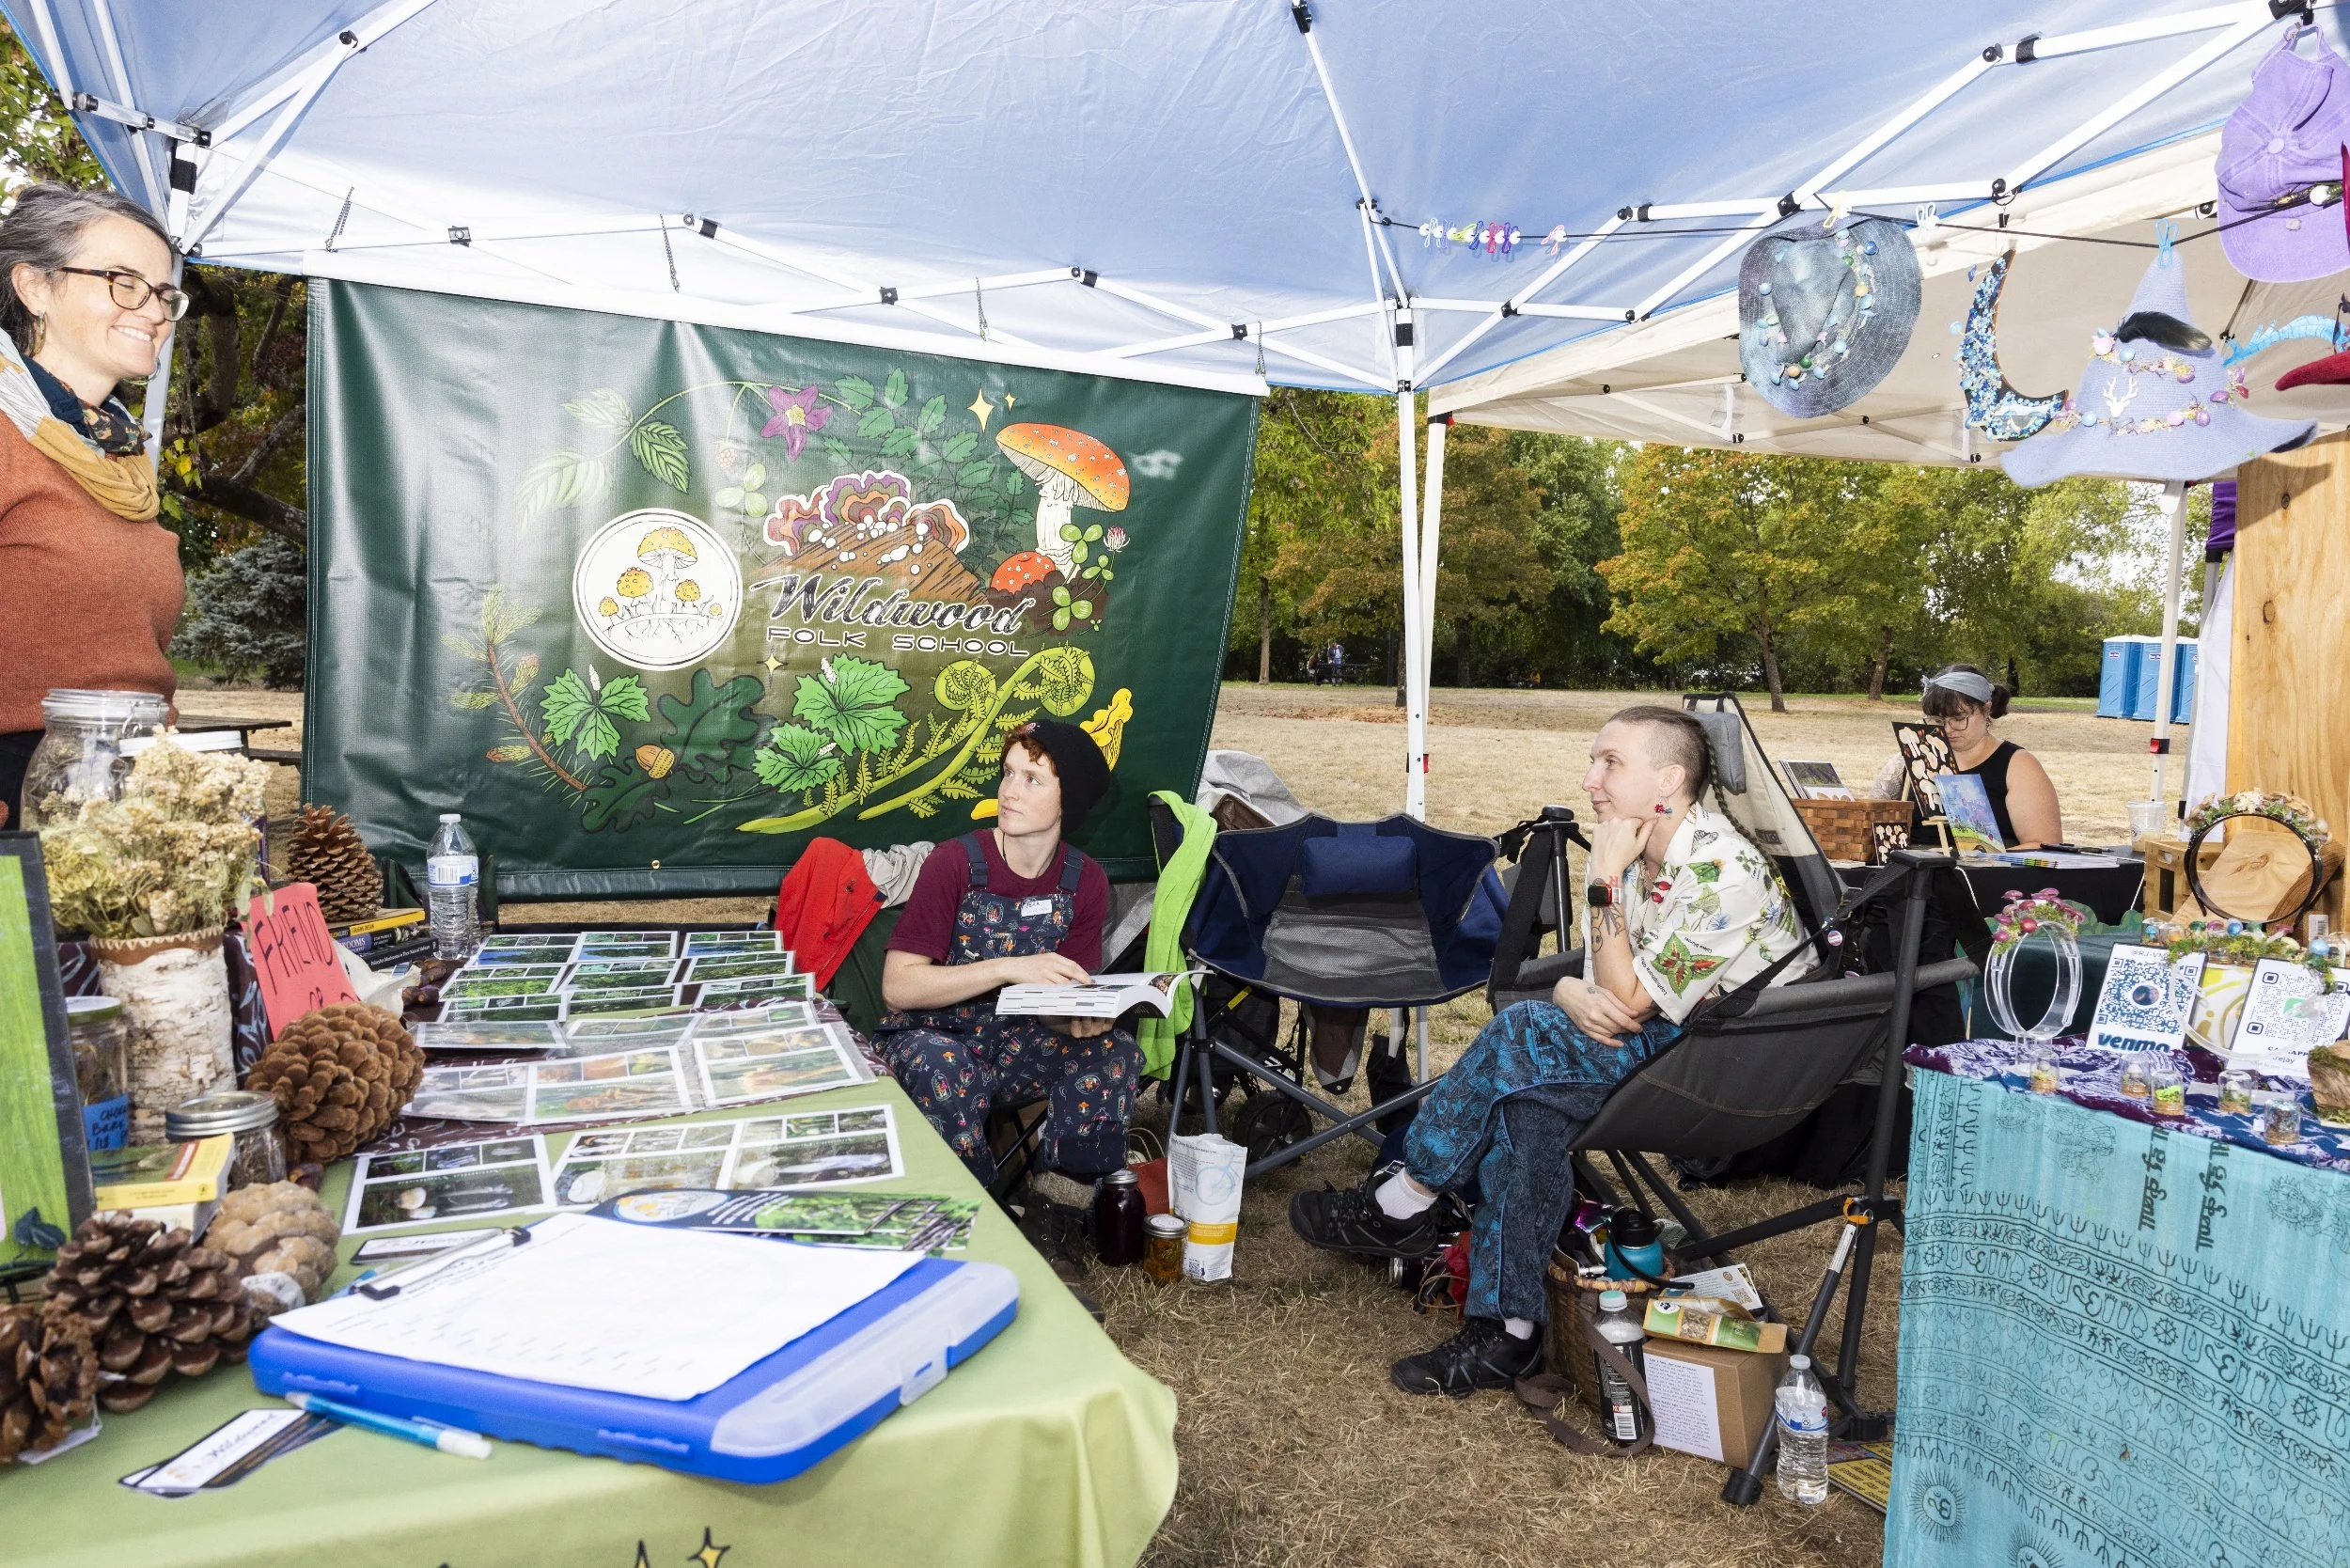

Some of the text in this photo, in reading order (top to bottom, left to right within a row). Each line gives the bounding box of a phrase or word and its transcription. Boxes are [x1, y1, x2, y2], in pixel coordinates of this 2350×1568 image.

[750, 574, 1035, 635] Wildwood
[766, 627, 1029, 658] FOLK SCHOOL
[255, 902, 334, 996] FRIEND
[2097, 1032, 2170, 1053] venmo
